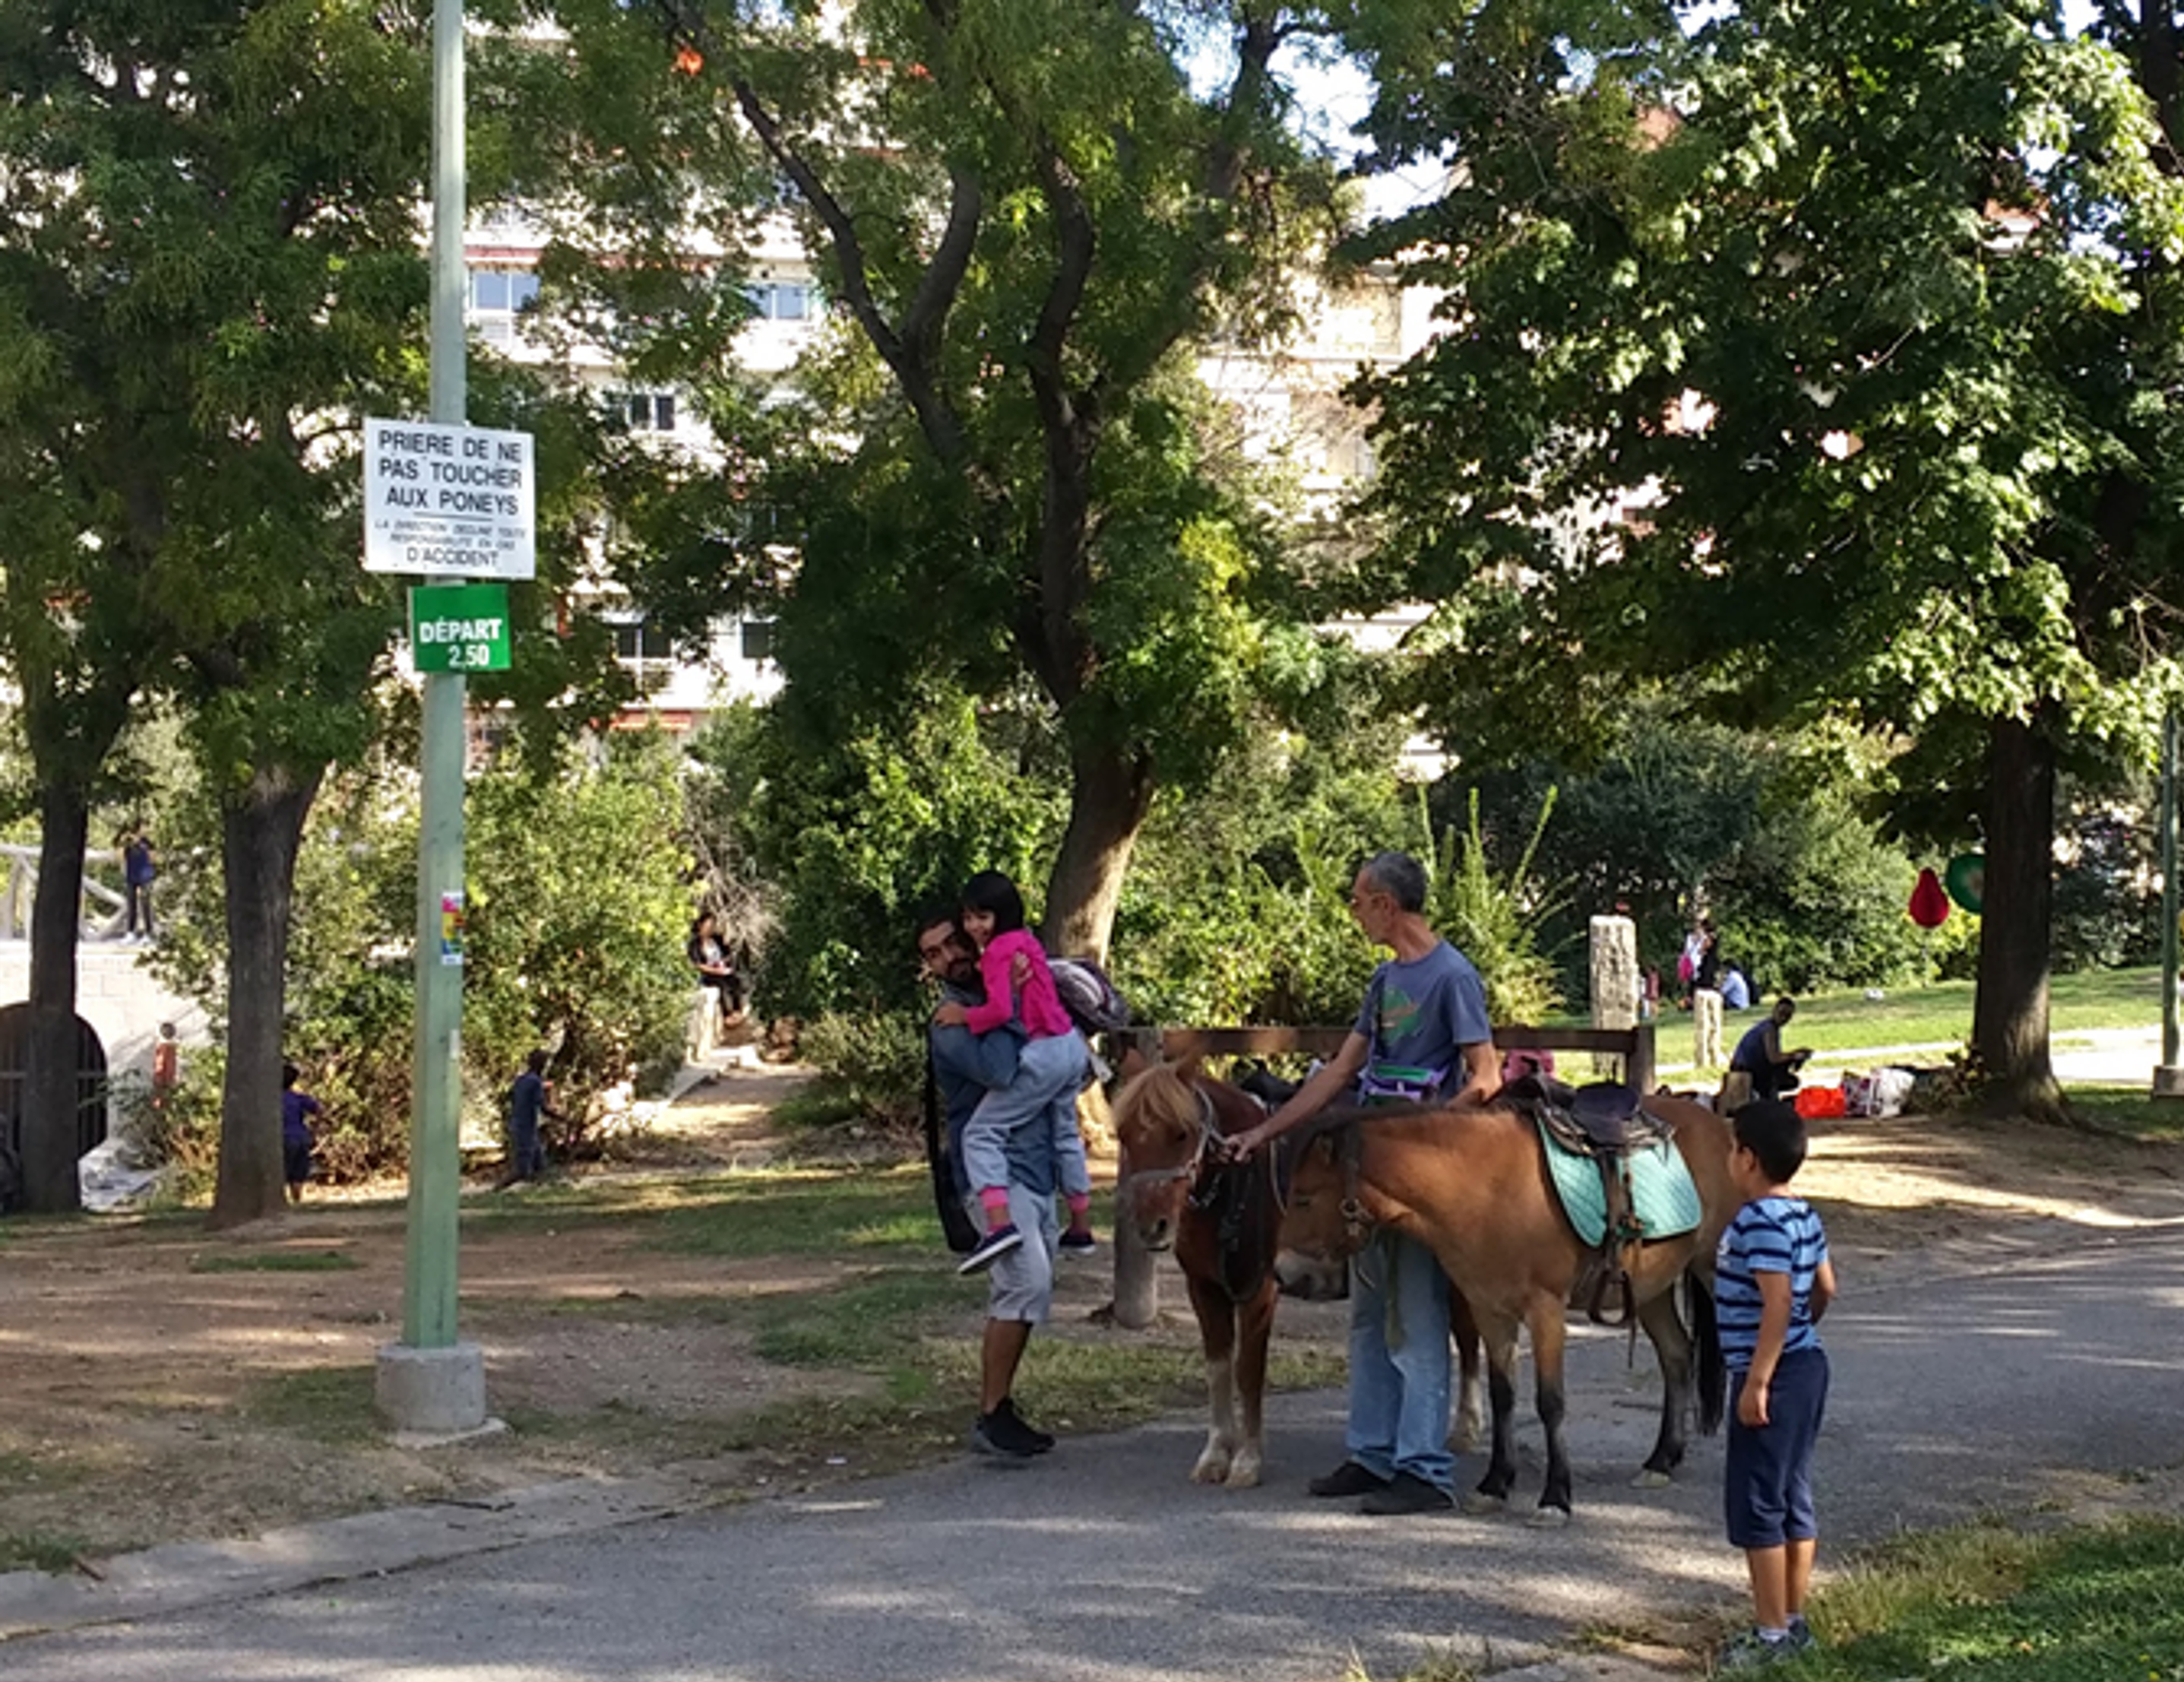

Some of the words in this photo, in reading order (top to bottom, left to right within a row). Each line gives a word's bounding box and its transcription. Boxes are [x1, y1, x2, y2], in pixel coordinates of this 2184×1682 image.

[378, 429, 453, 456] PRIERE
[463, 437, 489, 460] DE
[498, 442, 522, 463] NE
[378, 458, 418, 480] PAS
[430, 461, 522, 489] TOUCHER
[385, 486, 428, 508] AUX
[439, 491, 518, 515] PONEYS
[419, 616, 502, 643] DÉPART
